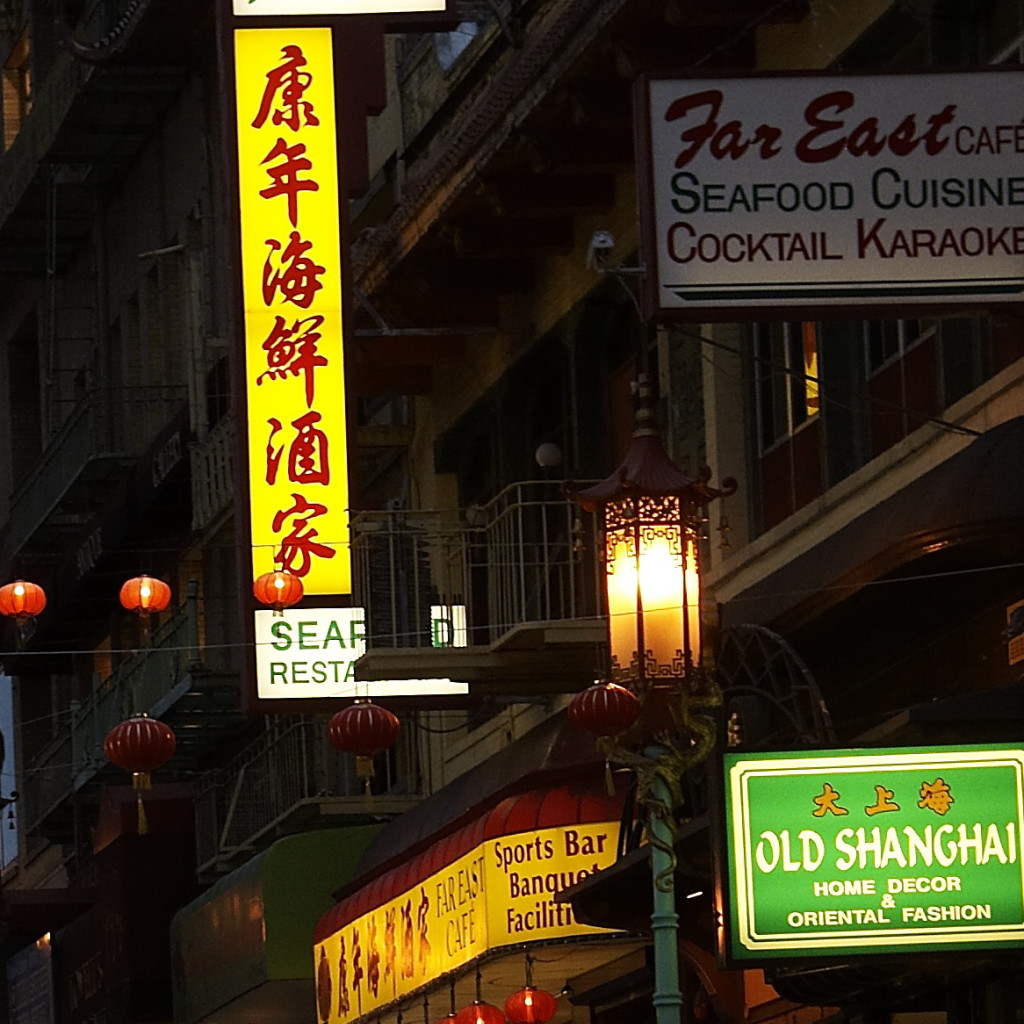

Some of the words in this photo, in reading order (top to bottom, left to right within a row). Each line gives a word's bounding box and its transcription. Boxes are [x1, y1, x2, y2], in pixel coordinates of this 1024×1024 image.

[664, 89, 783, 169] Far
[795, 90, 958, 164] East
[670, 171, 854, 214] SEAFOOD
[872, 167, 1024, 210] CUISINE
[667, 221, 843, 264] COCKTAIL
[856, 218, 1024, 260] KARAOKE
[494, 836, 554, 873] Sports
[564, 830, 608, 857] Bar
[755, 829, 825, 874] OLD
[835, 822, 1017, 872] SHANGHAI
[813, 880, 876, 897] HOME
[887, 876, 961, 895] DECOR
[881, 894, 896, 909] &
[507, 900, 573, 934] Faciliti
[787, 909, 891, 928] ORIENTAL
[902, 904, 992, 923] FASHION
